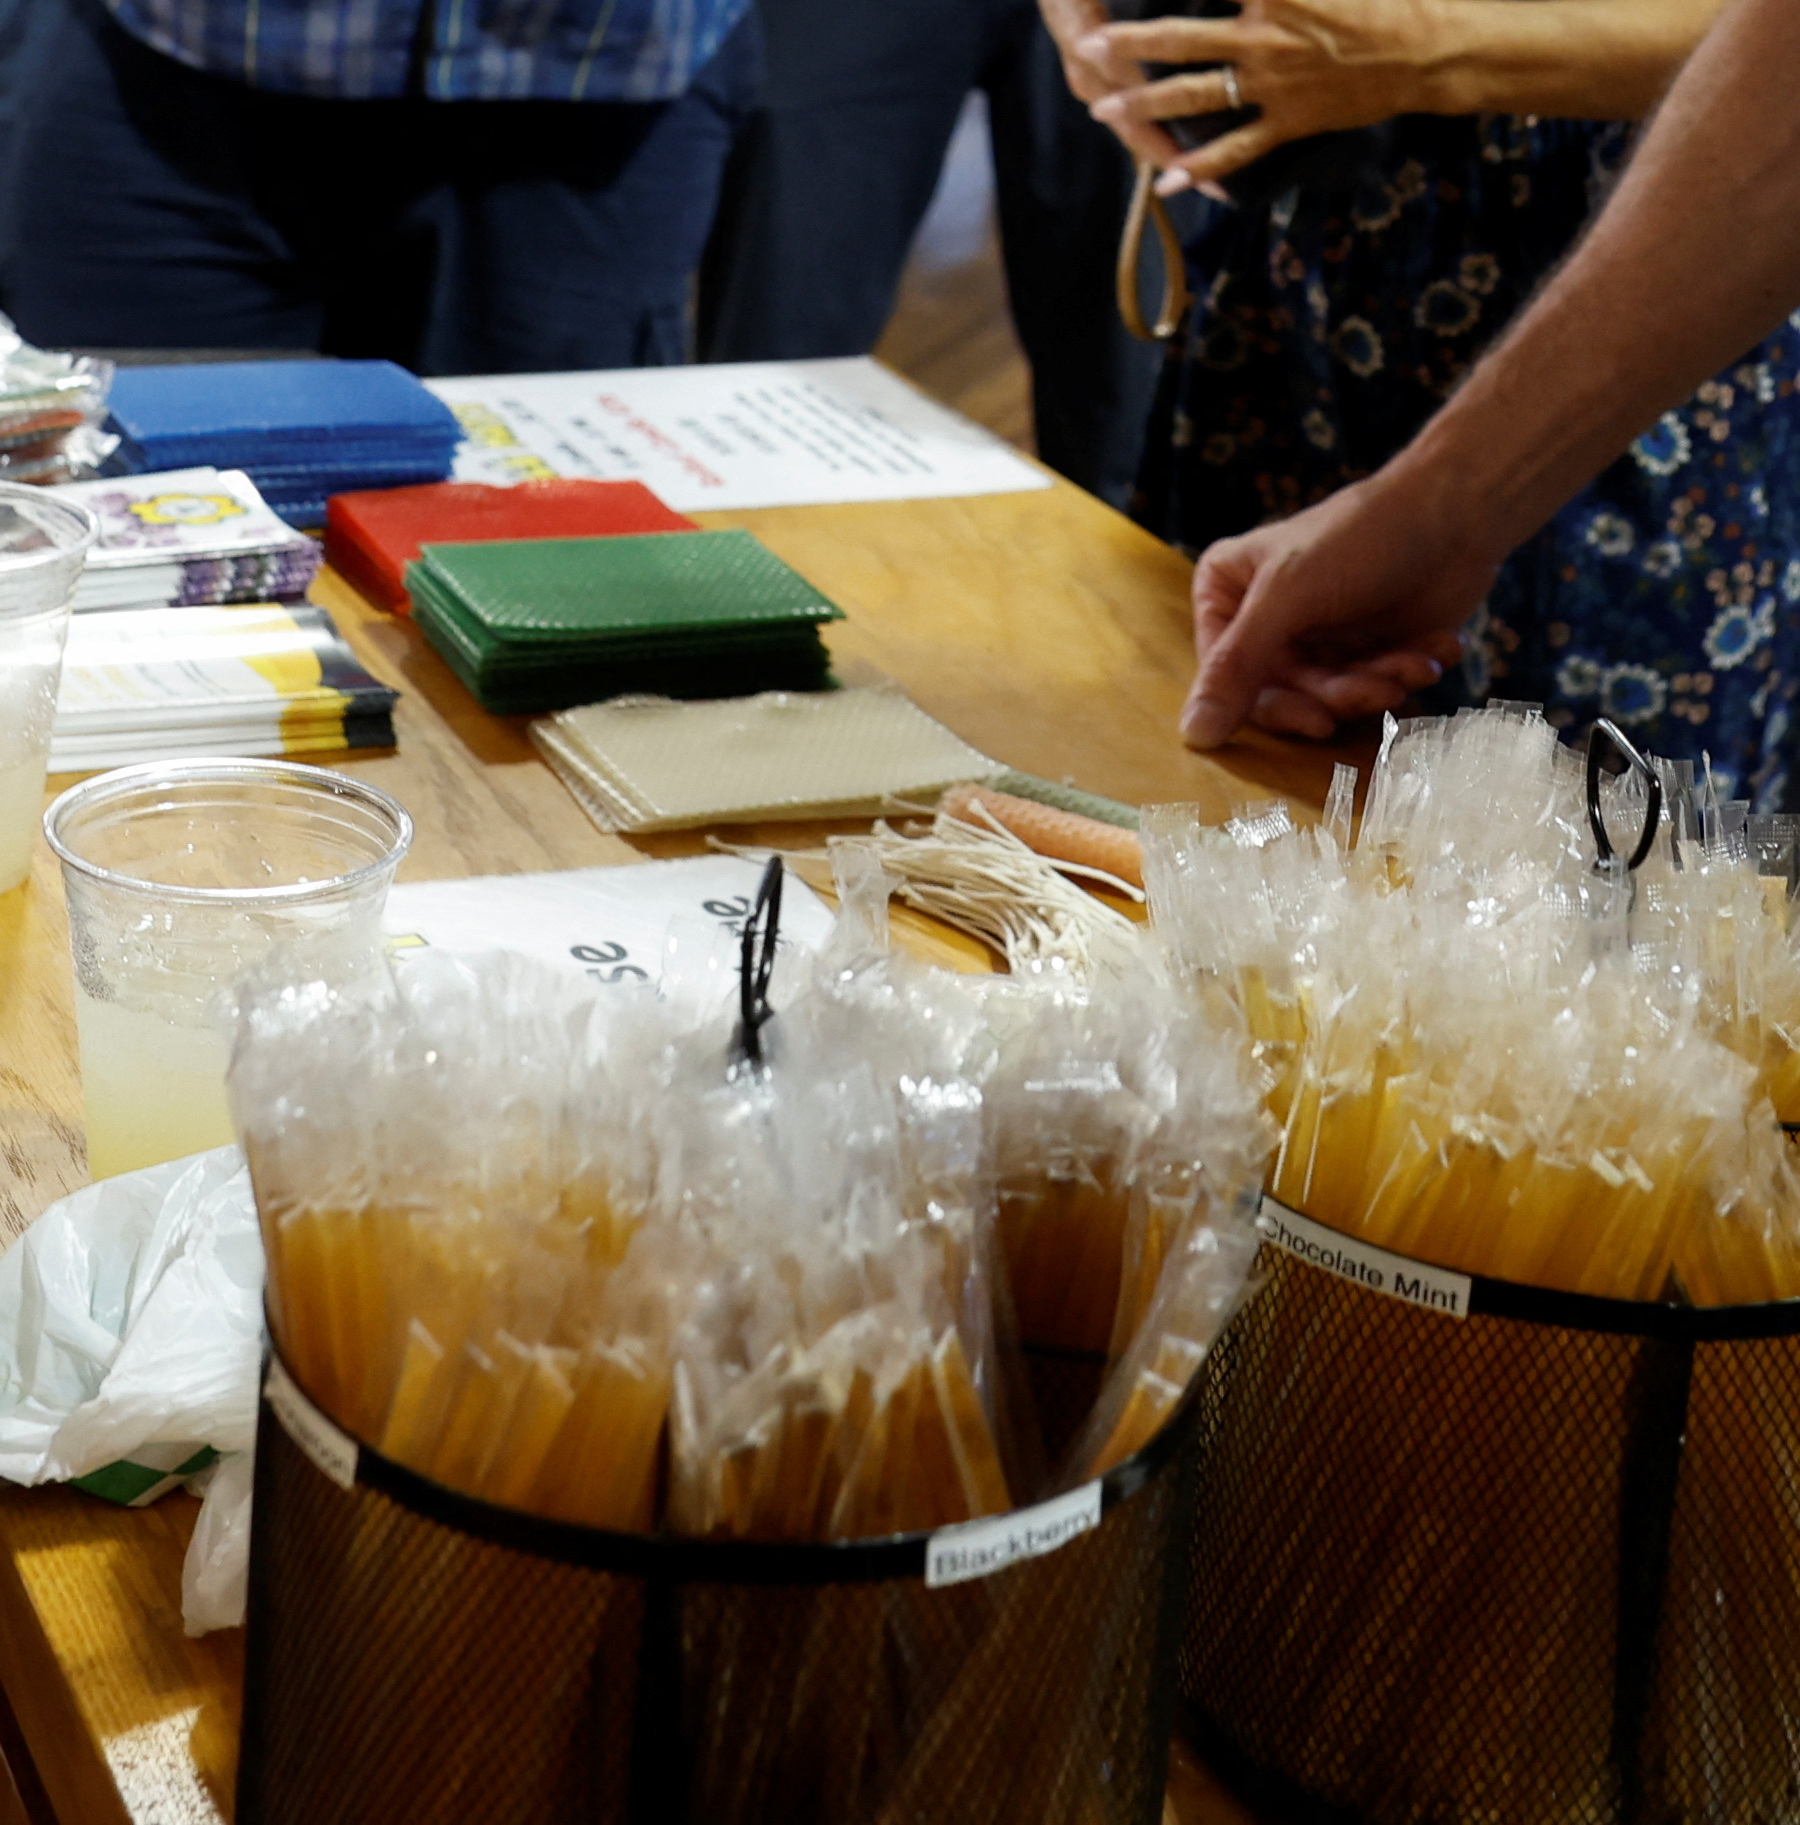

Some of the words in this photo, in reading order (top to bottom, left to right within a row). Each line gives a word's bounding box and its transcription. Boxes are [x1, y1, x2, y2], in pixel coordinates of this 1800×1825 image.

[1265, 1216, 1384, 1287] Chocolate
[1394, 1272, 1459, 1311] Mint
[935, 1505, 1096, 1575] Blackberry
